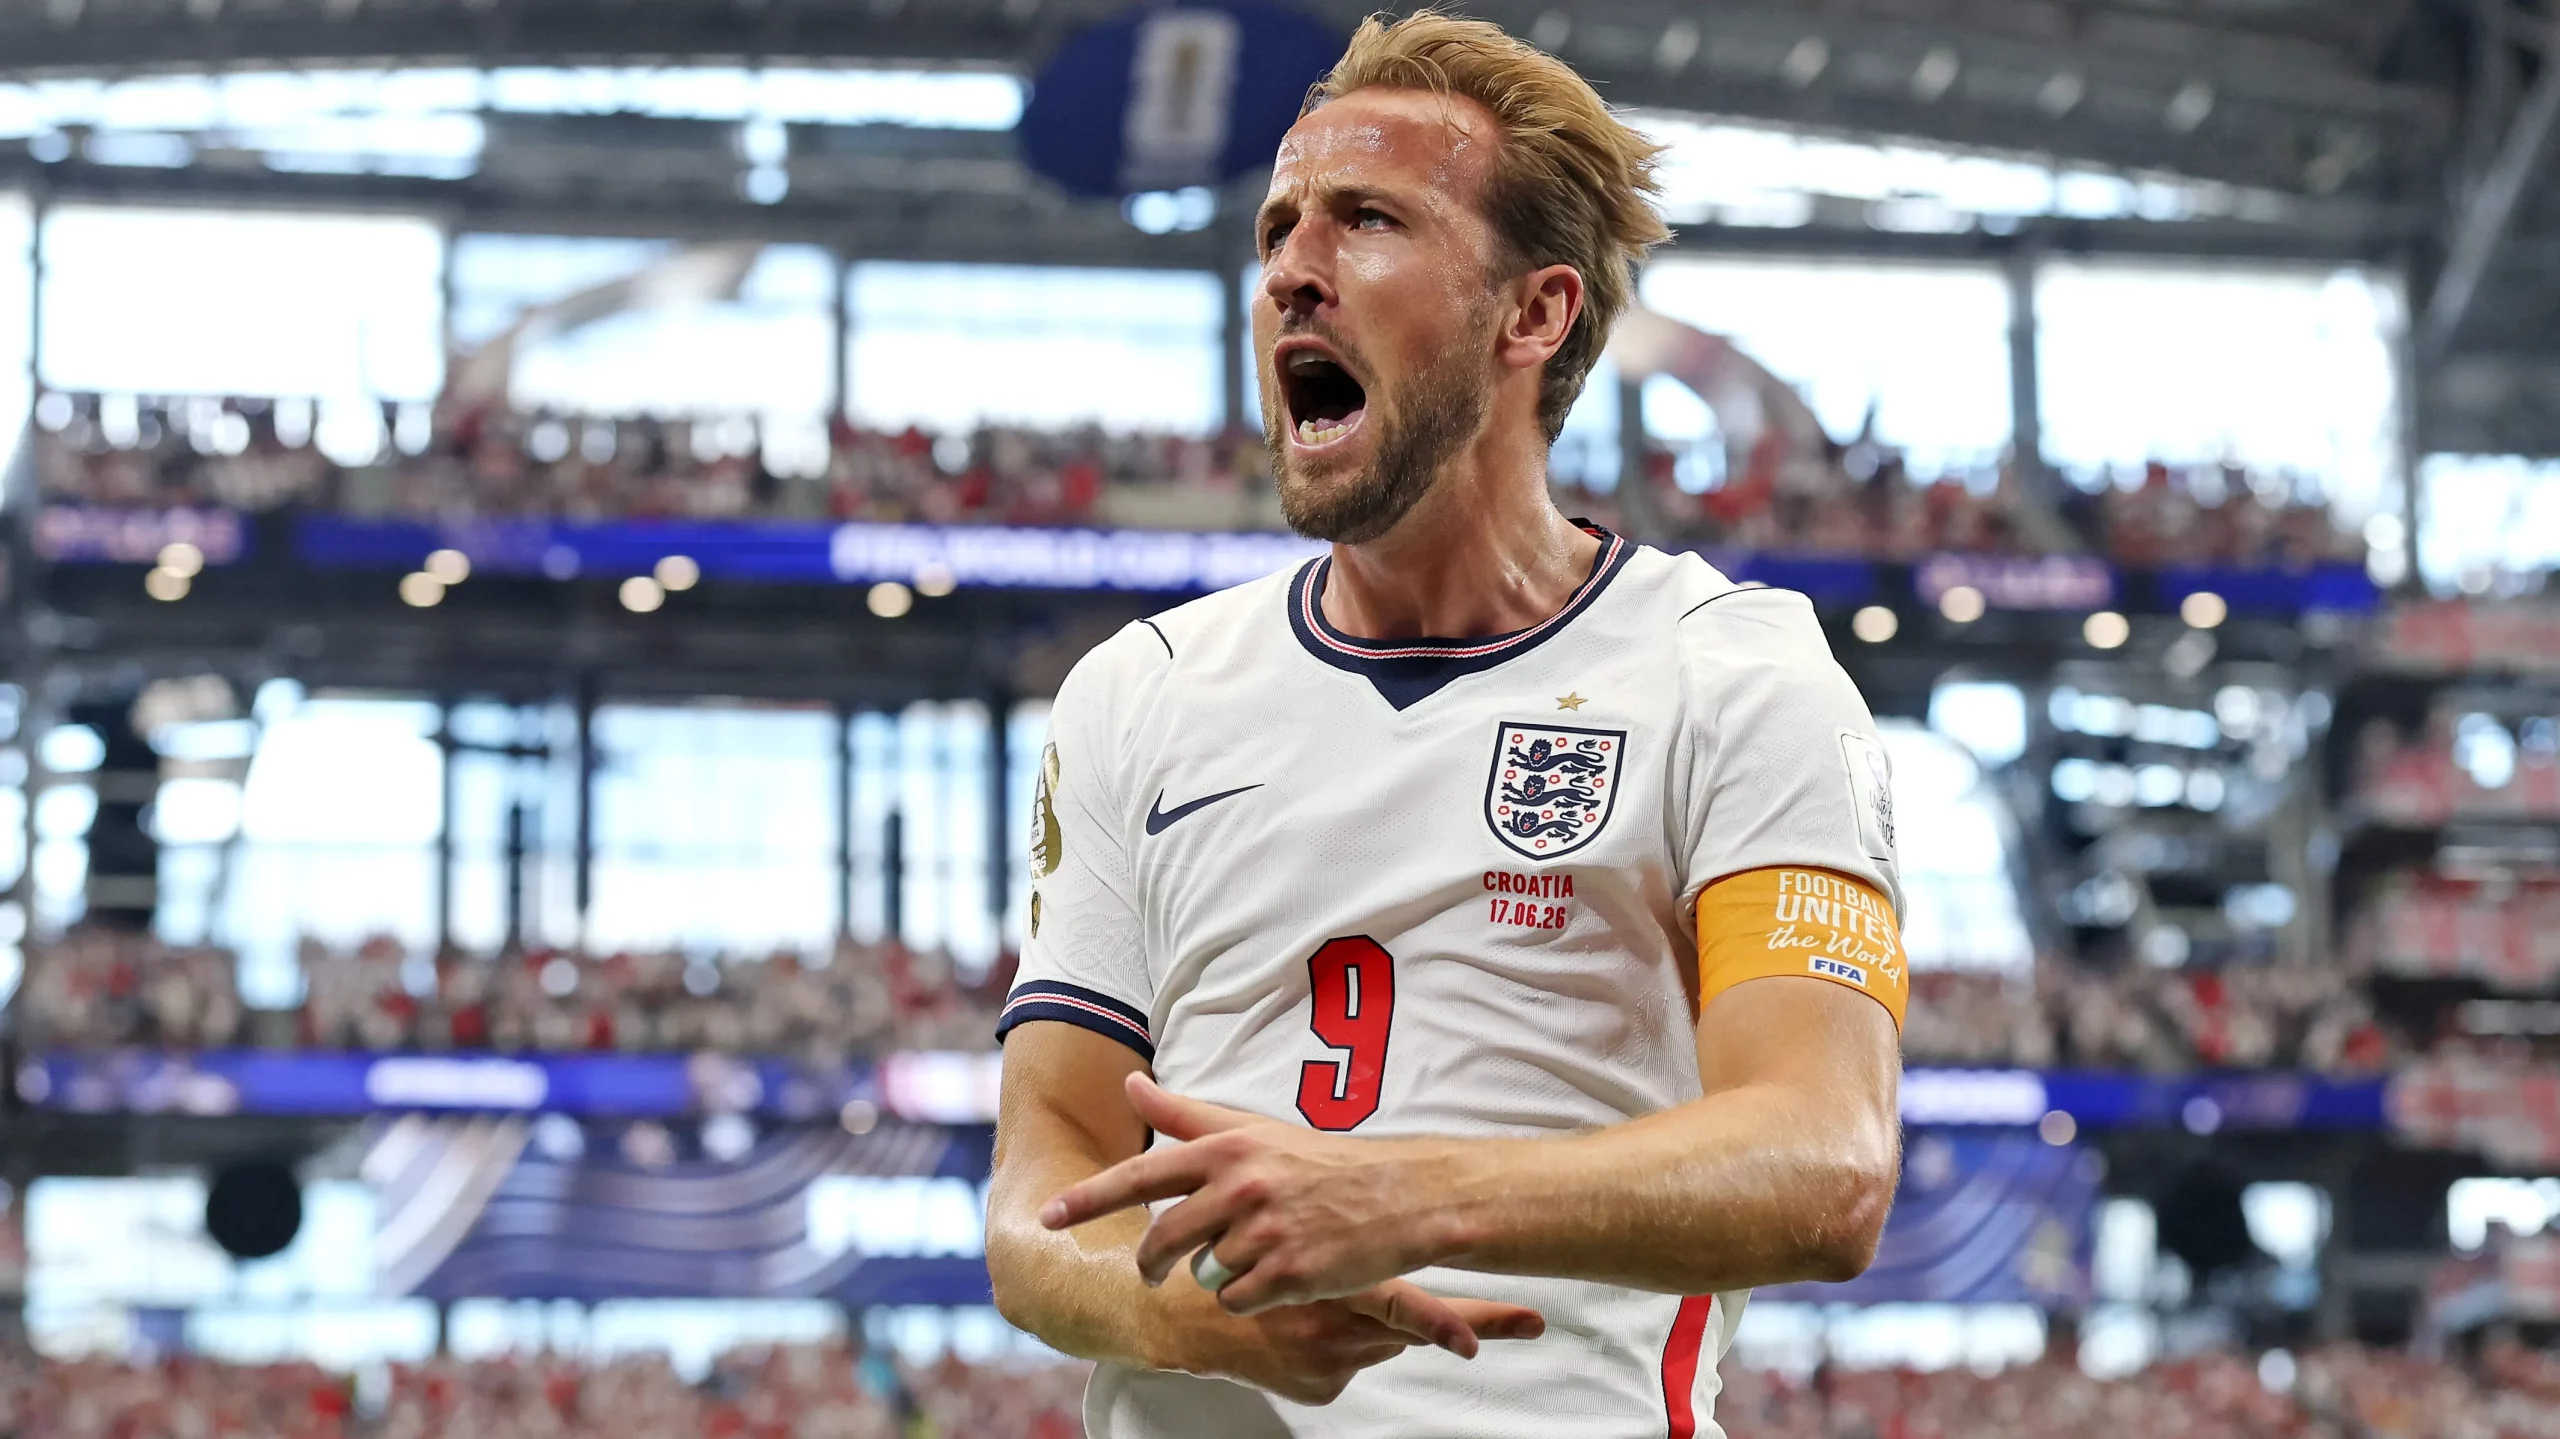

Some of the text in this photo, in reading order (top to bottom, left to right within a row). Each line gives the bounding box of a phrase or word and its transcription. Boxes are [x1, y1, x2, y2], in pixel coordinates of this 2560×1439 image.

[1483, 870, 1574, 899] CROATIA
[1489, 898, 1566, 930] 17.06.26
[1779, 871, 1893, 930] FOOTBALL
[1775, 893, 1897, 956] UNITES
[1764, 924, 1901, 988] the World
[1814, 958, 1863, 984] FIFA
[1295, 934, 1396, 1132] 9
